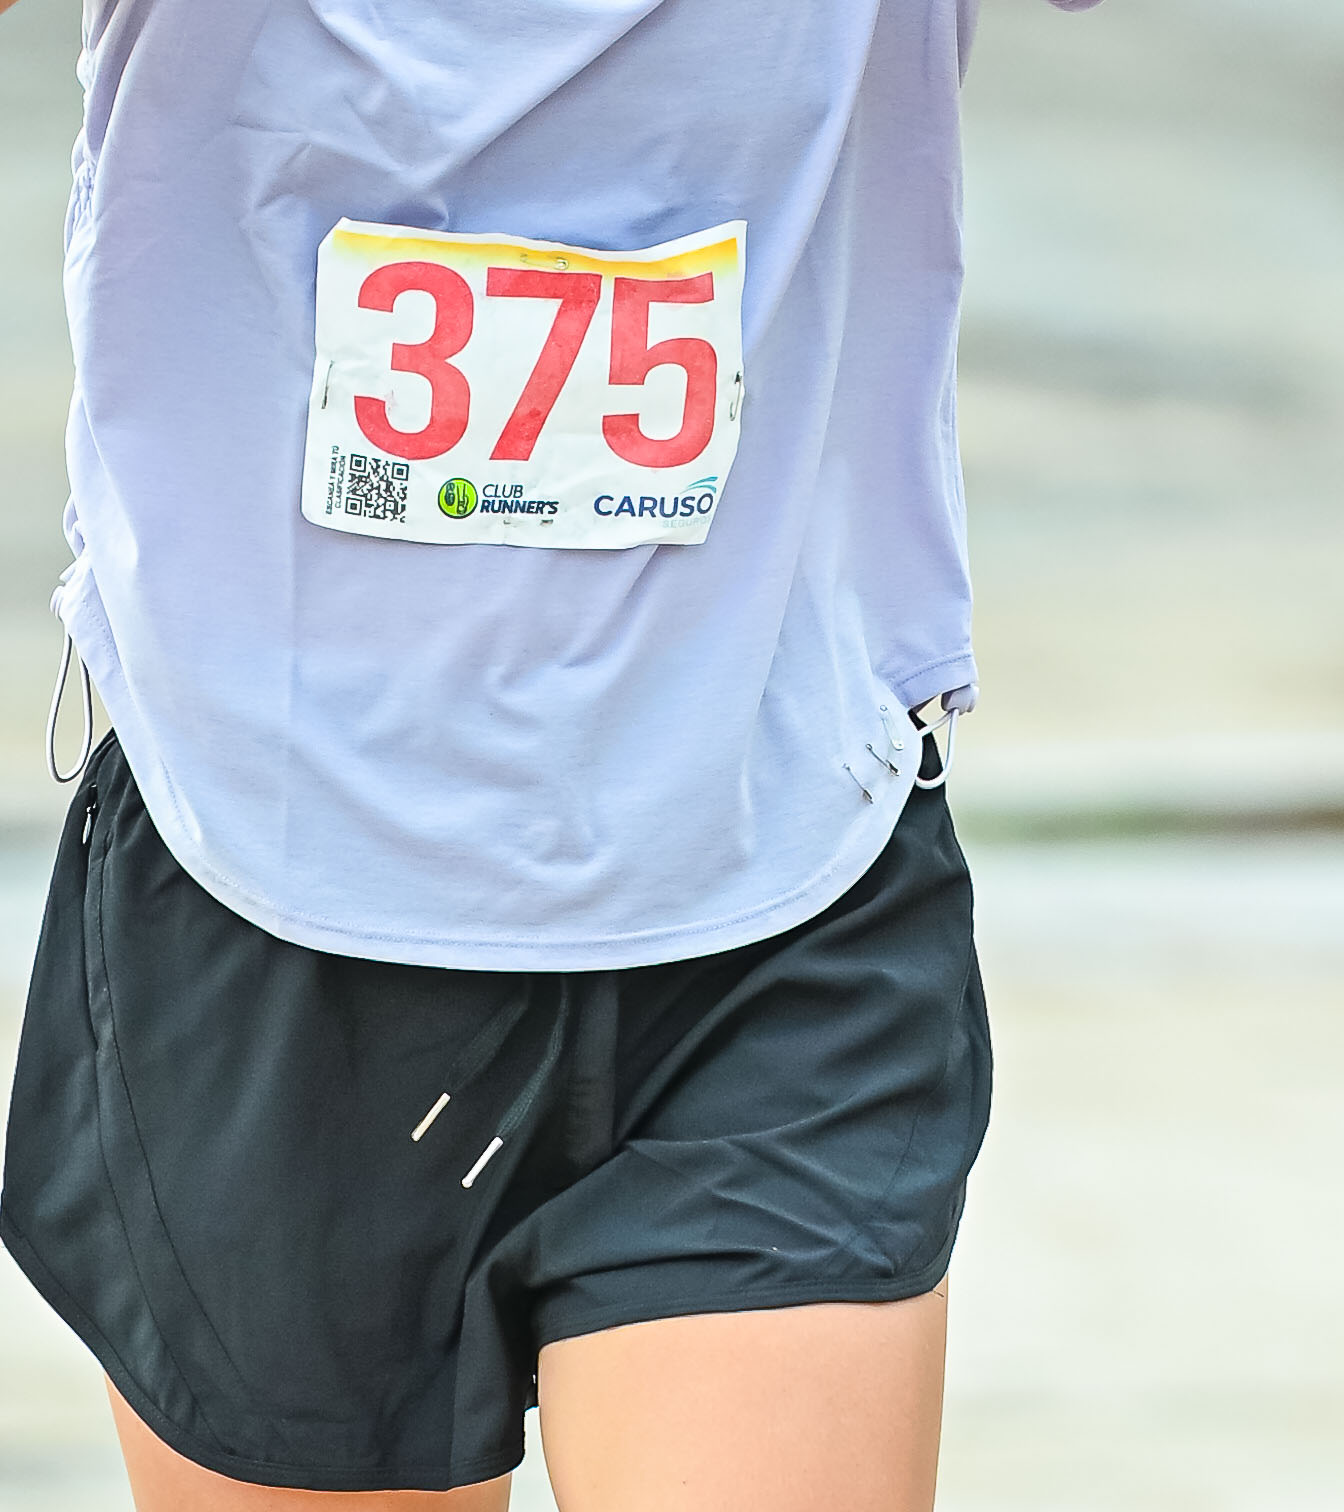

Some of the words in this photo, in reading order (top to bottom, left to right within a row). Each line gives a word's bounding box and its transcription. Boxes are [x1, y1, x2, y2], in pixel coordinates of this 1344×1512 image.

[353, 261, 718, 468] 375
[482, 483, 524, 499] CLUB
[480, 499, 560, 515] RUNNER'S
[593, 492, 714, 519] CARUSO
